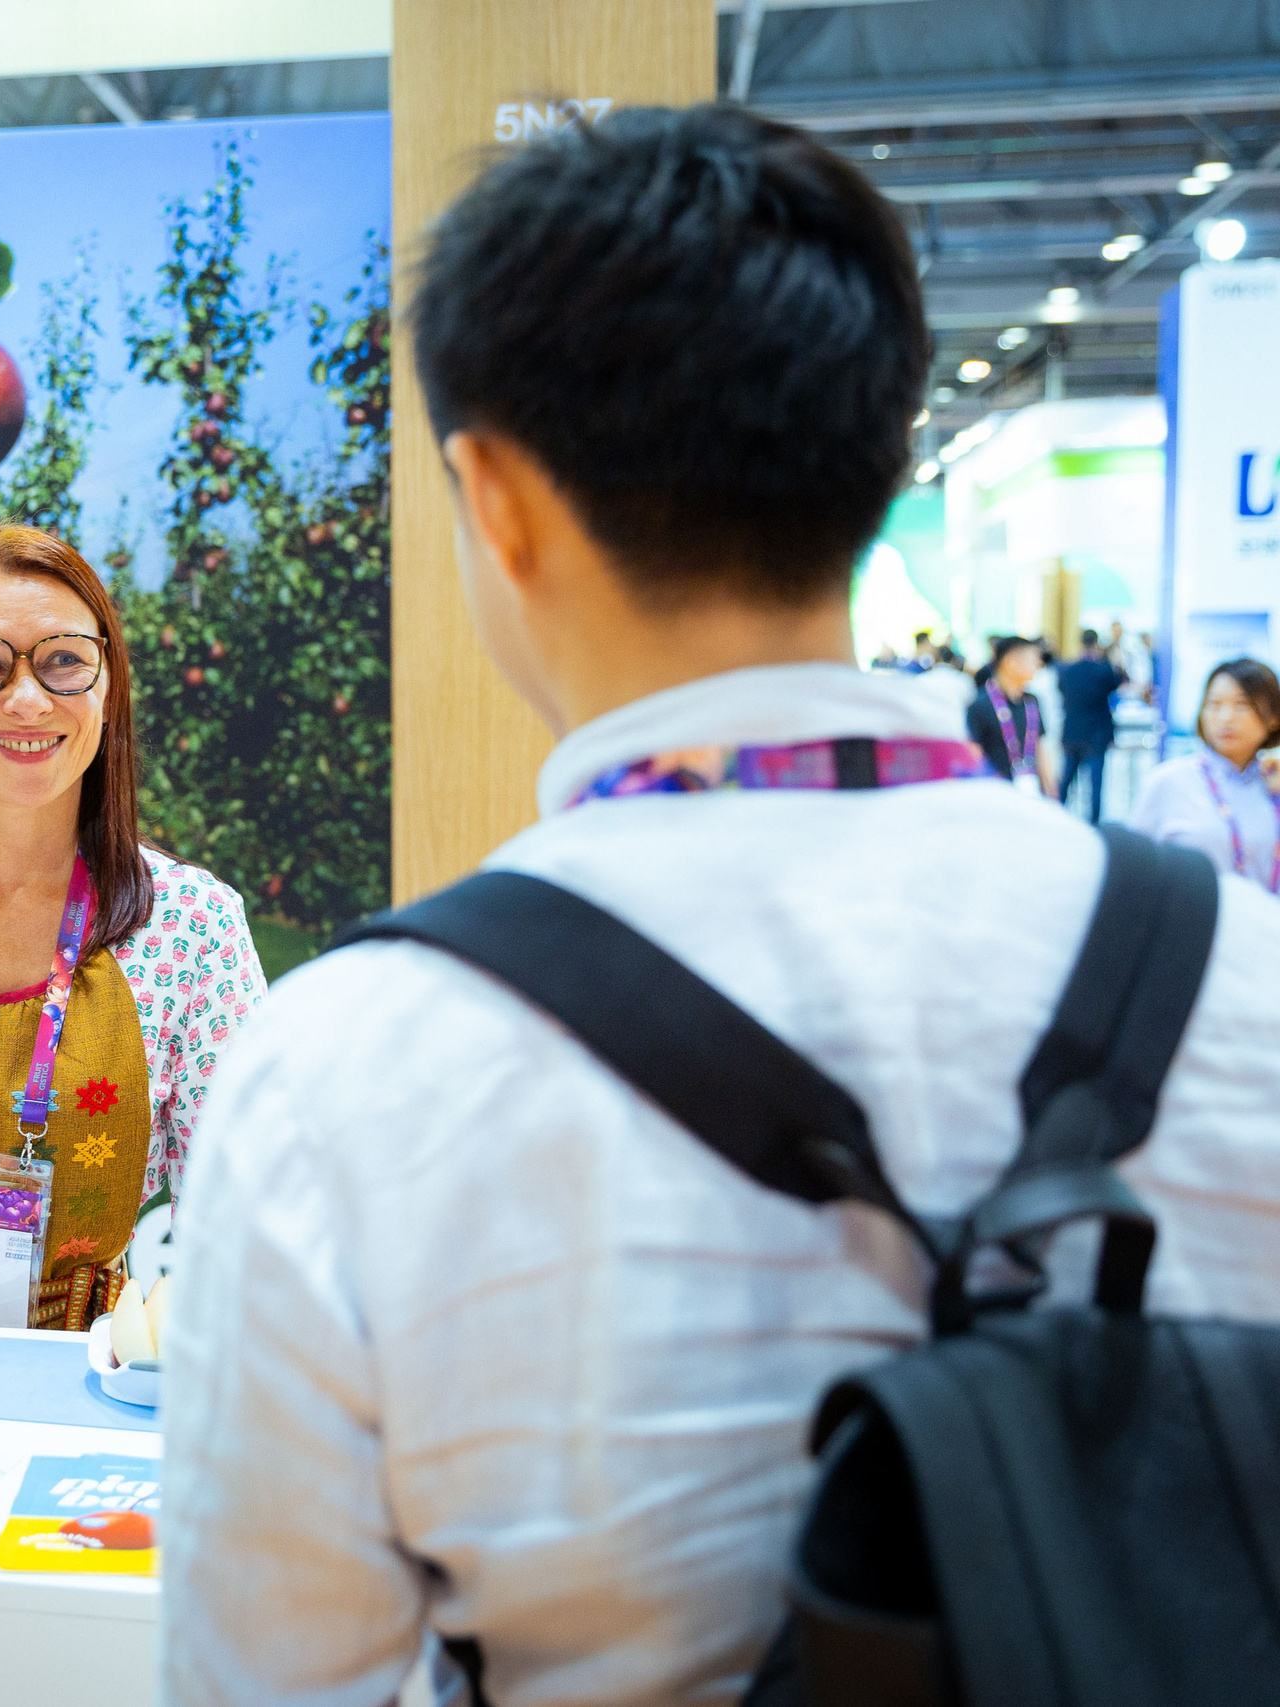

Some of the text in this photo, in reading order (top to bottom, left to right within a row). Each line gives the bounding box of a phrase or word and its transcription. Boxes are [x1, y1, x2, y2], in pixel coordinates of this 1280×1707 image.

[67, 901, 78, 920] FRUIT
[72, 902, 85, 936] LOGISTICA
[33, 1062, 42, 1083] FRUIT
[37, 1063, 50, 1100] LOGISTICA
[50, 1474, 162, 1498] piq
